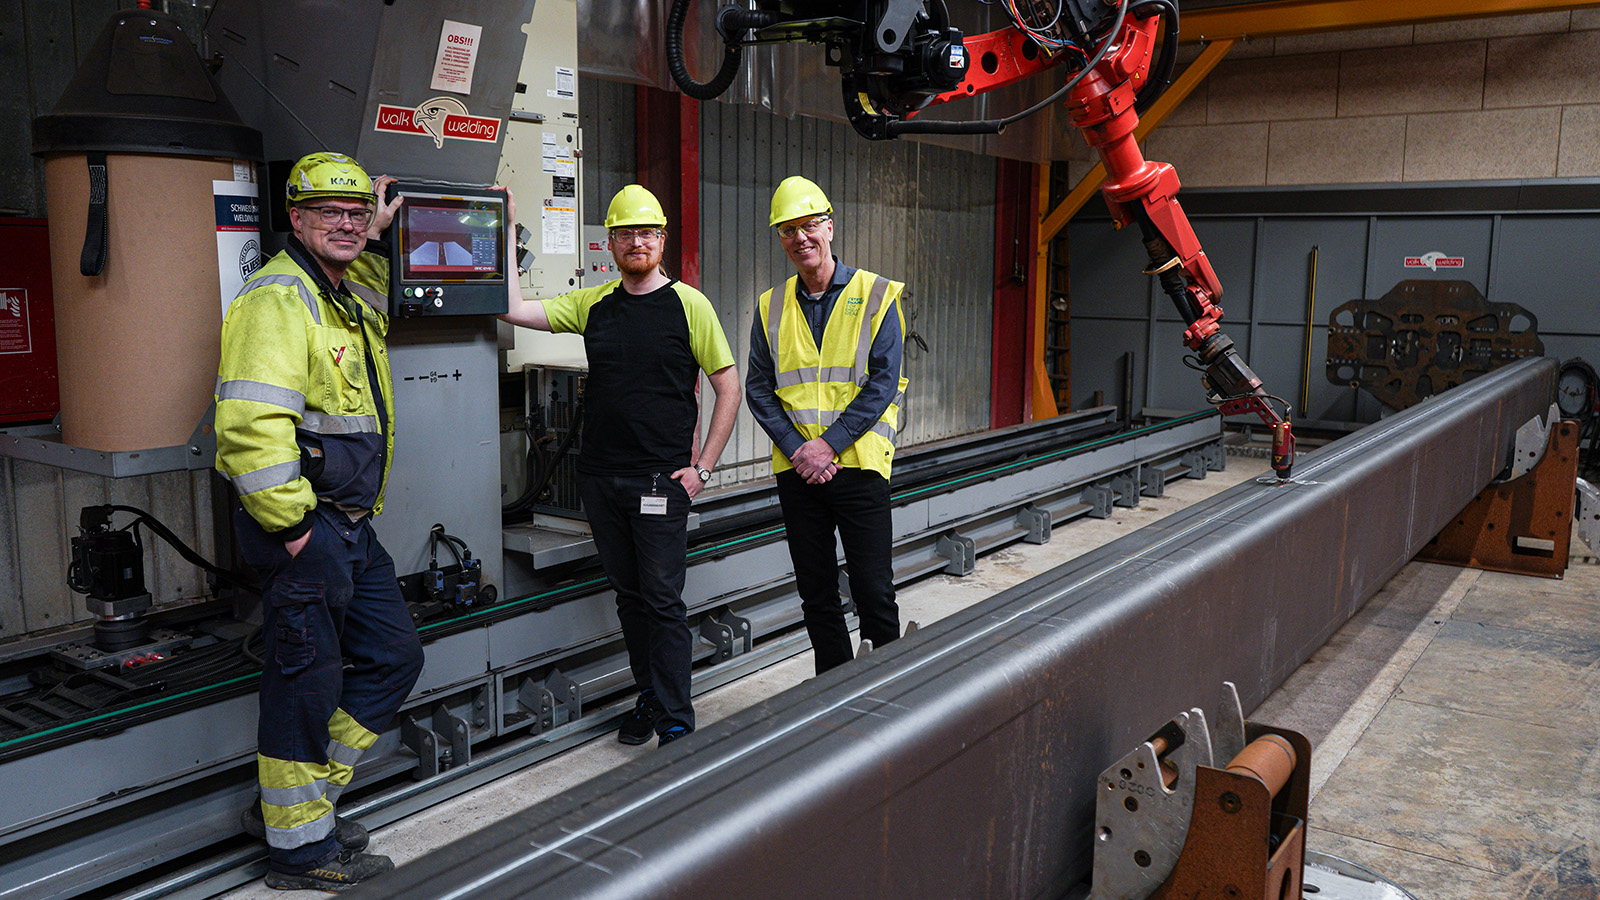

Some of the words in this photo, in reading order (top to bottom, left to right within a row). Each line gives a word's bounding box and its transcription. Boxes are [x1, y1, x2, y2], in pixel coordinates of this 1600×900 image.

[447, 34, 473, 47] OBS!!!
[382, 112, 410, 127] valk
[448, 121, 496, 139] welding
[330, 178, 358, 187] KASK
[307, 868, 346, 881] ATOX
